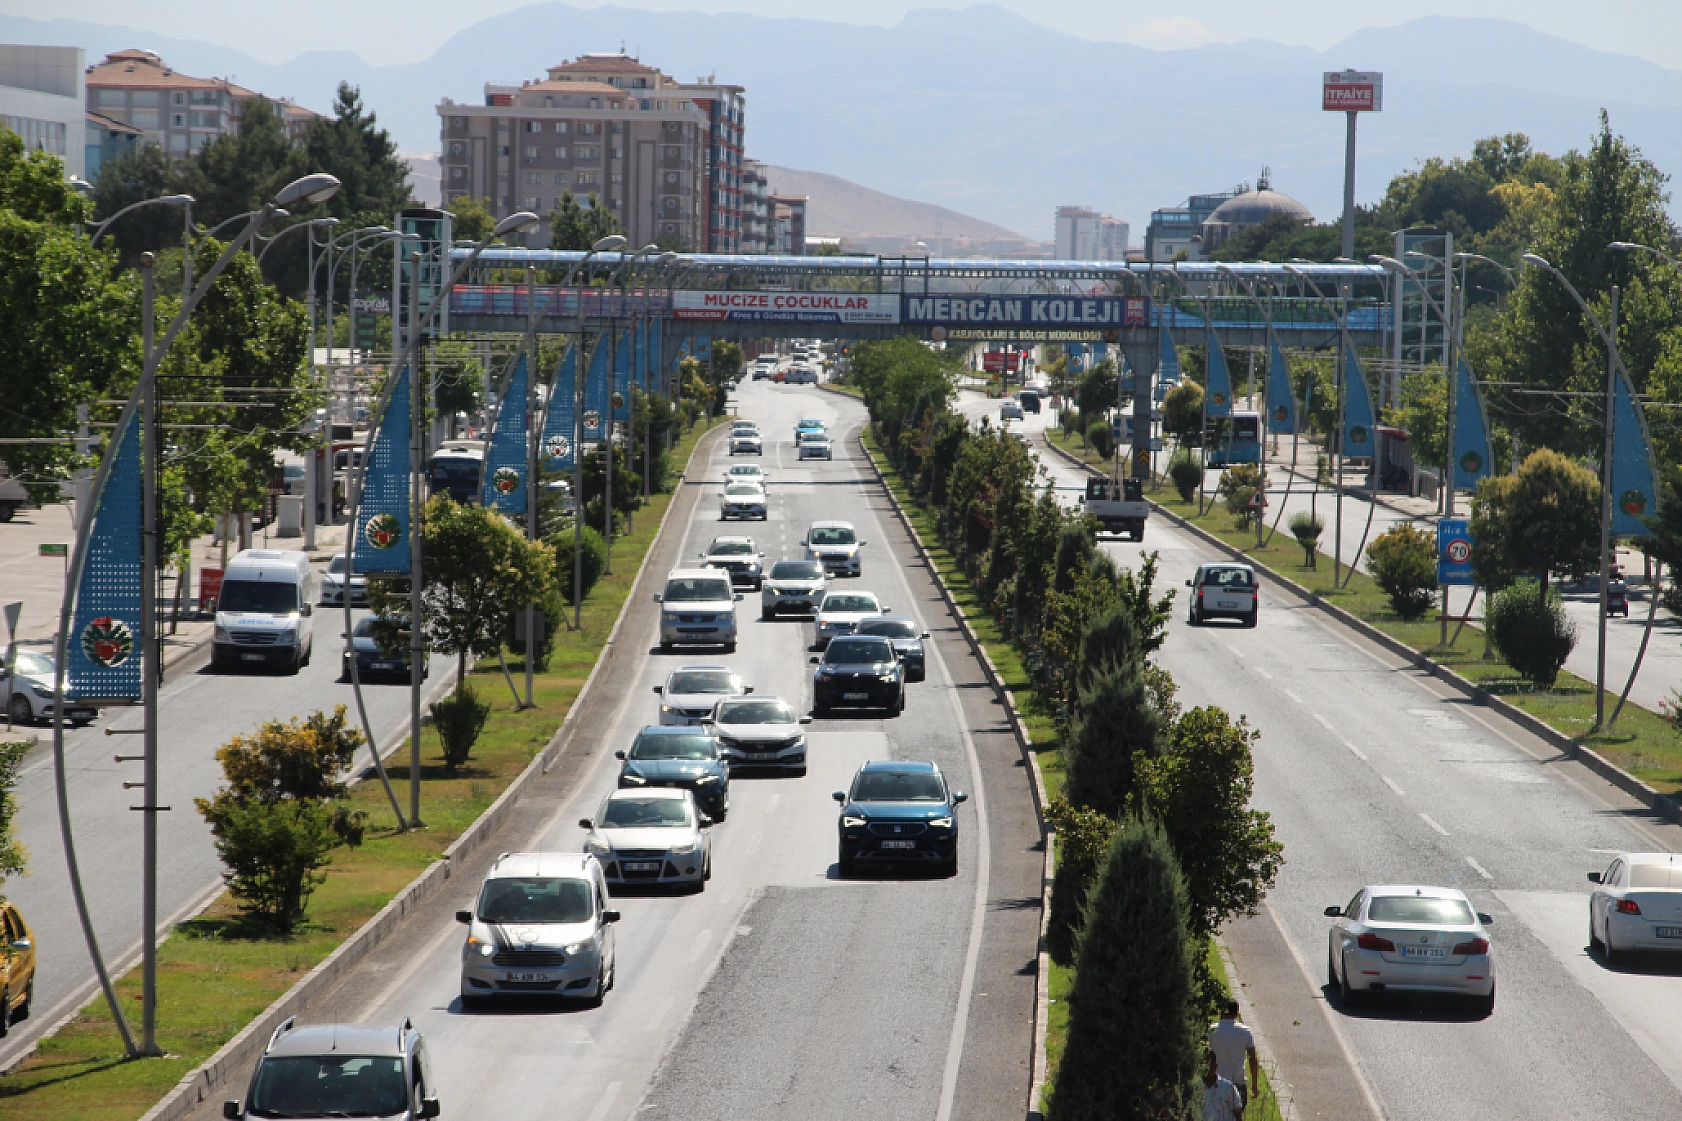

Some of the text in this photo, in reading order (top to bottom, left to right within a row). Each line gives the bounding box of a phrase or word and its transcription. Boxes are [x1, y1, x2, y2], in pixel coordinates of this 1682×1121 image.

[704, 293, 869, 309] MUCİZE ÇOCUKLAR
[908, 298, 1120, 323] MERCAN KOLEJİ
[1019, 329, 1047, 340] BÖLGE
[1452, 546, 1467, 558] 70
